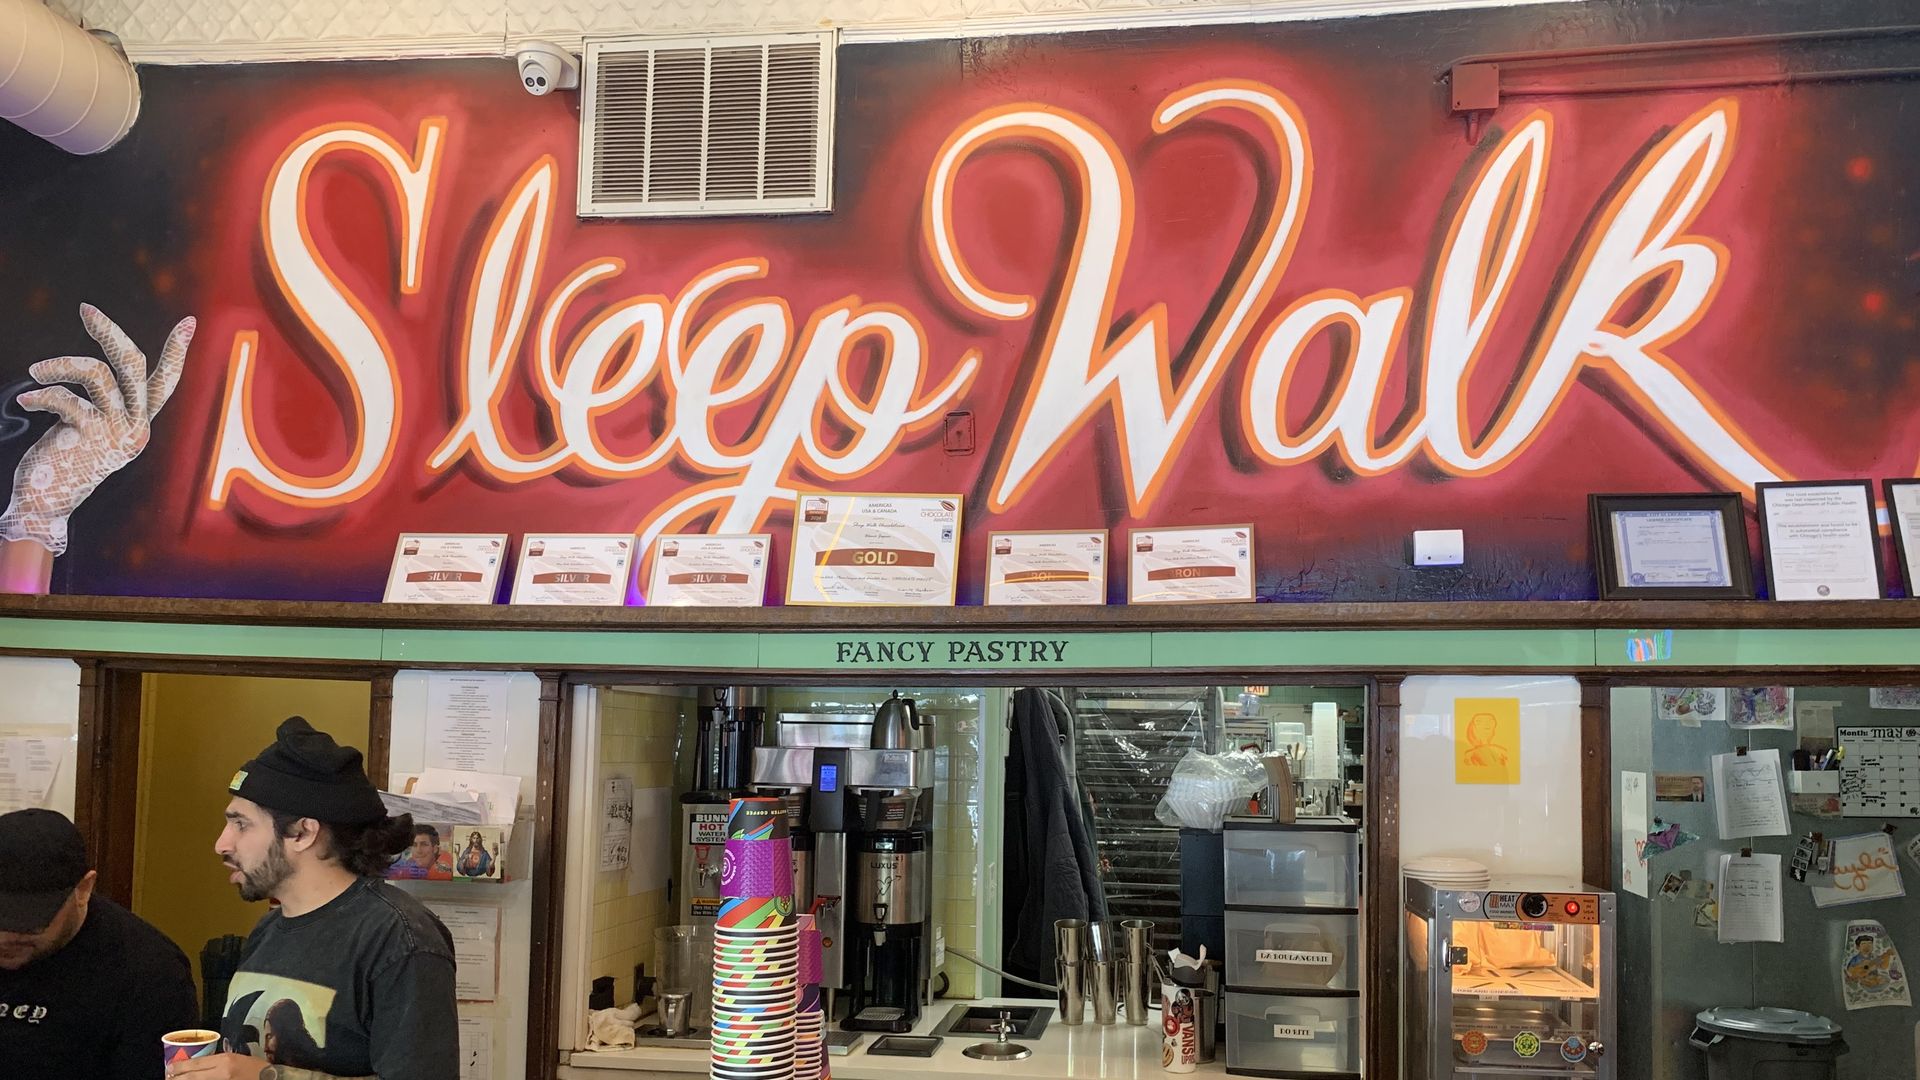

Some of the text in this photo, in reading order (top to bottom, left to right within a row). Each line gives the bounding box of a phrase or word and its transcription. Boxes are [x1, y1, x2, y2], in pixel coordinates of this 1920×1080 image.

[208, 82, 1888, 600] Sleep Walk
[852, 551, 898, 564] GOLD
[427, 573, 462, 581] SILVR
[554, 574, 590, 582] SILVR
[690, 575, 727, 583] SILVR
[836, 640, 1069, 662] FANCY PASTRY
[1273, 953, 1328, 962] BOULANGERIE
[1182, 1025, 1195, 1055] VANS
